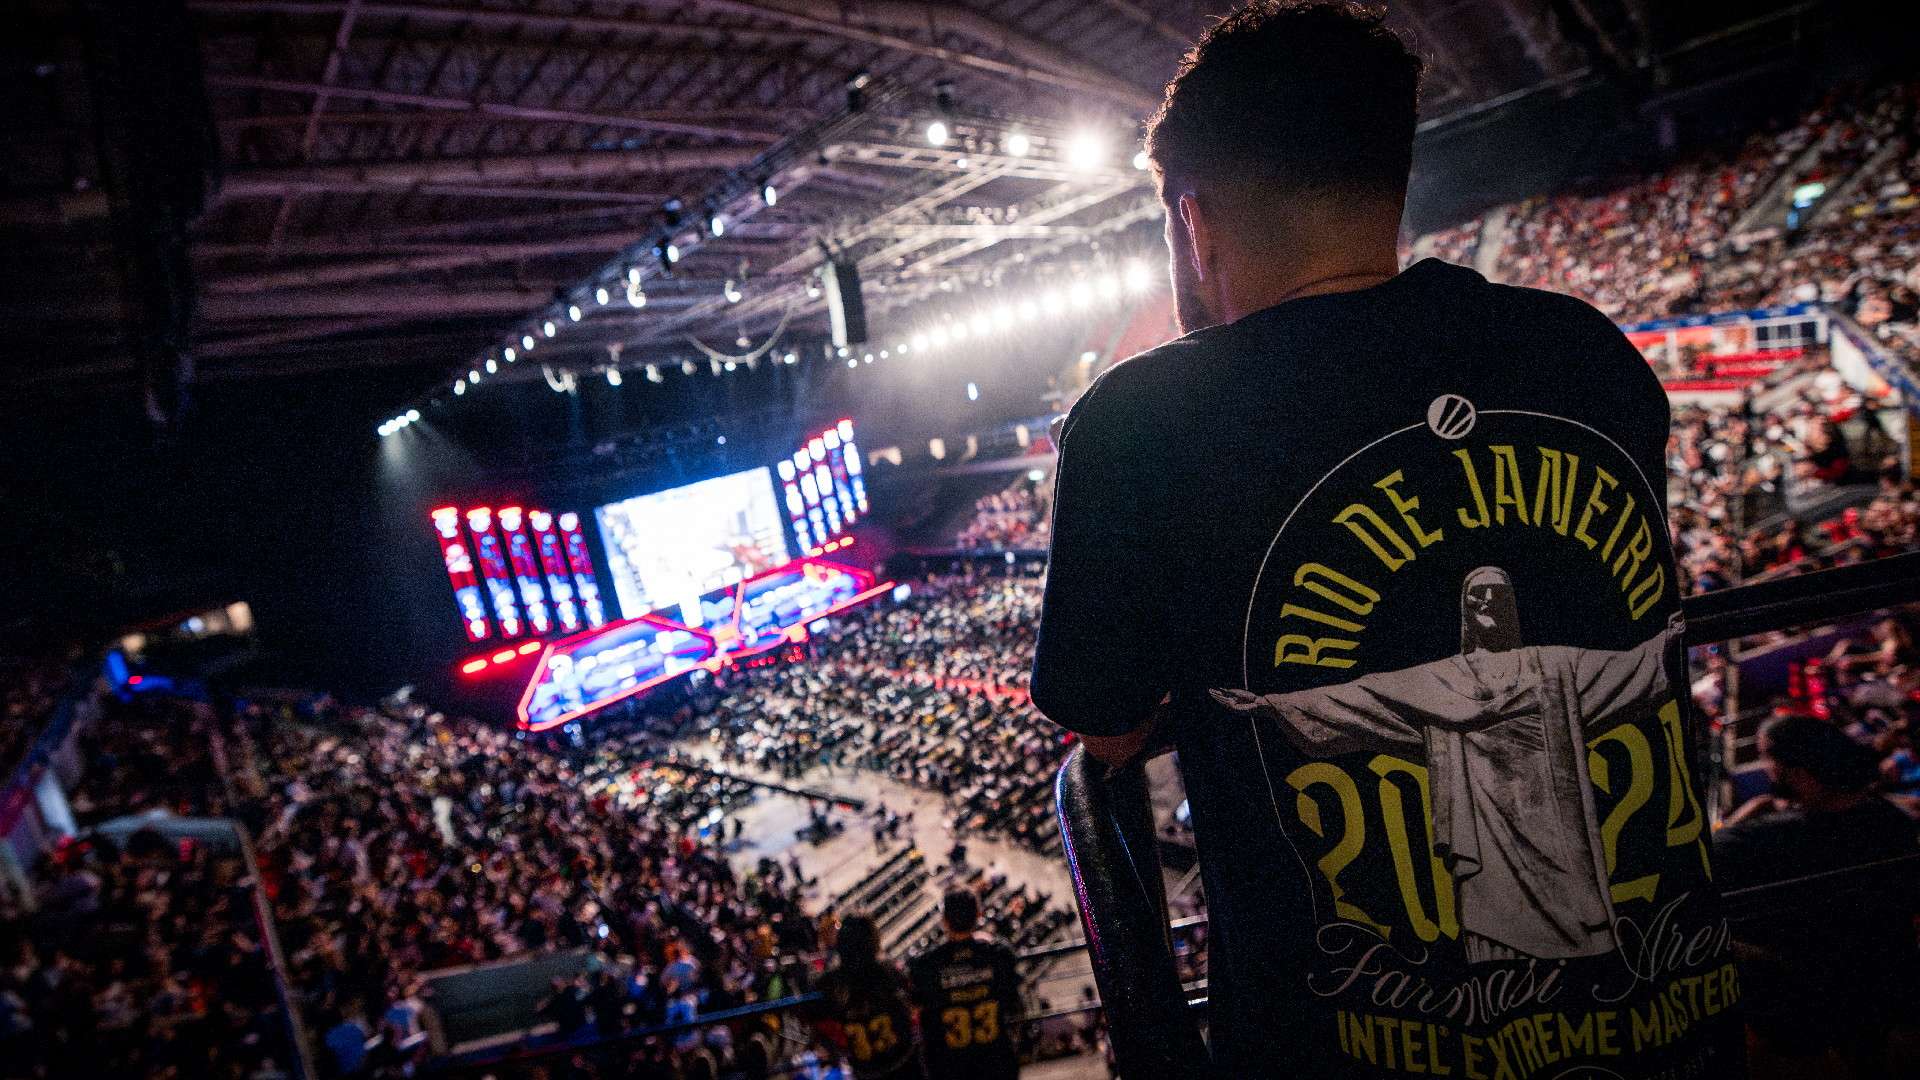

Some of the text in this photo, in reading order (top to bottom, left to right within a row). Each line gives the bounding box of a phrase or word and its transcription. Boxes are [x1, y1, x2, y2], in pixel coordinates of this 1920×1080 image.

[1274, 445, 1666, 669] RIO DE JANEIRO
[942, 1000, 999, 1049] 33
[1307, 921, 1567, 1027] Farmasi
[1462, 1010, 1621, 1080] EXTREME
[1631, 962, 1742, 1053] MASTER
